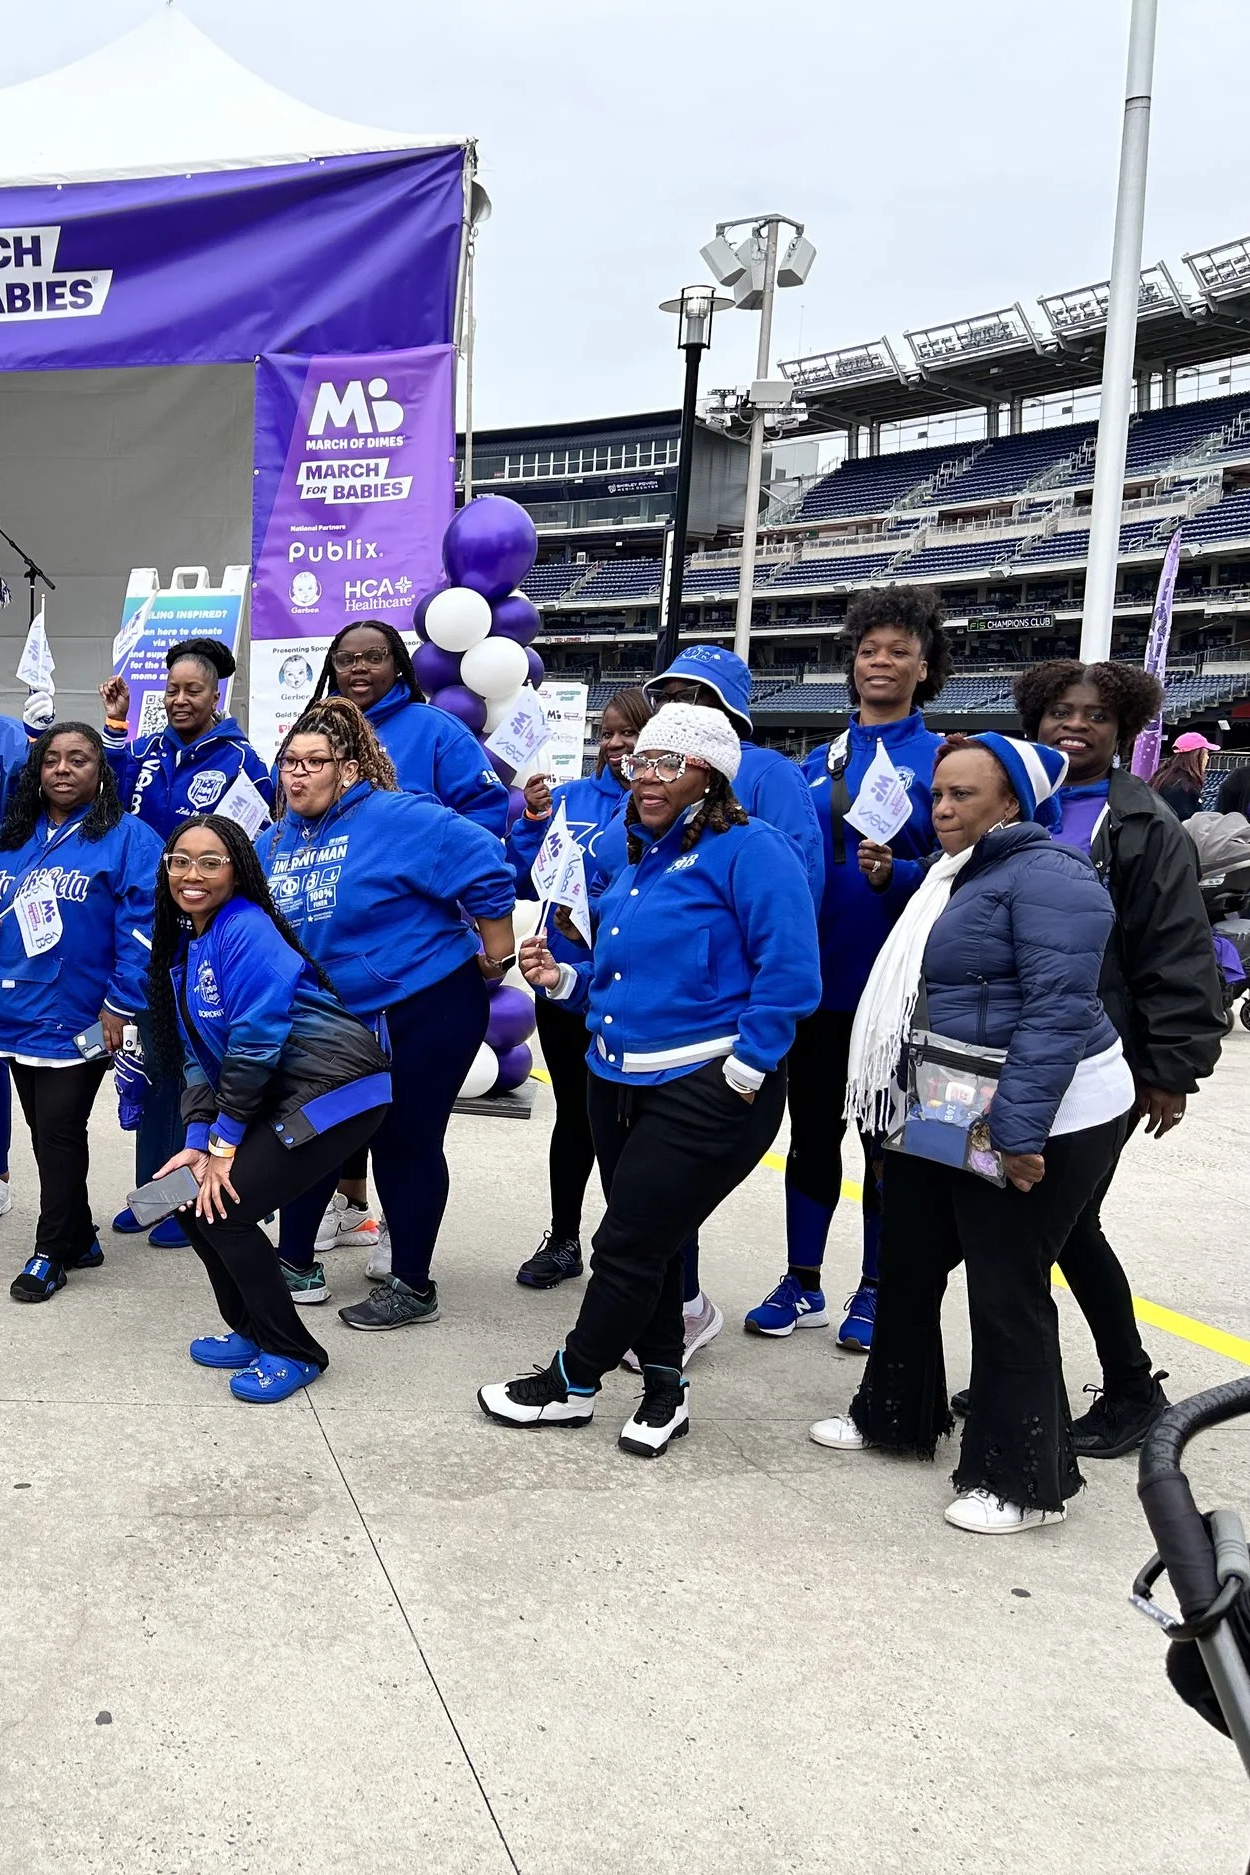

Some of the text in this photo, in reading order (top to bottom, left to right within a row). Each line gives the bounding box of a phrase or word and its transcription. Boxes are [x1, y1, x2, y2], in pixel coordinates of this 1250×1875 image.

[306, 436, 404, 450] MARCH OF DIMES
[305, 463, 380, 480] MARCH
[305, 482, 403, 500] FOR BABIES
[290, 523, 346, 532] National Partners
[345, 578, 393, 599] HCA
[345, 597, 412, 612] Healthcare
[176, 609, 228, 620] INSPIRED?
[987, 618, 1029, 629] CHAMPIONS
[1030, 617, 1050, 627] CLUB
[157, 628, 178, 636] here
[191, 627, 223, 636] donate
[153, 638, 166, 646] via
[272, 646, 310, 654] Presenting
[144, 661, 159, 669] the
[310, 889, 333, 902] 100%
